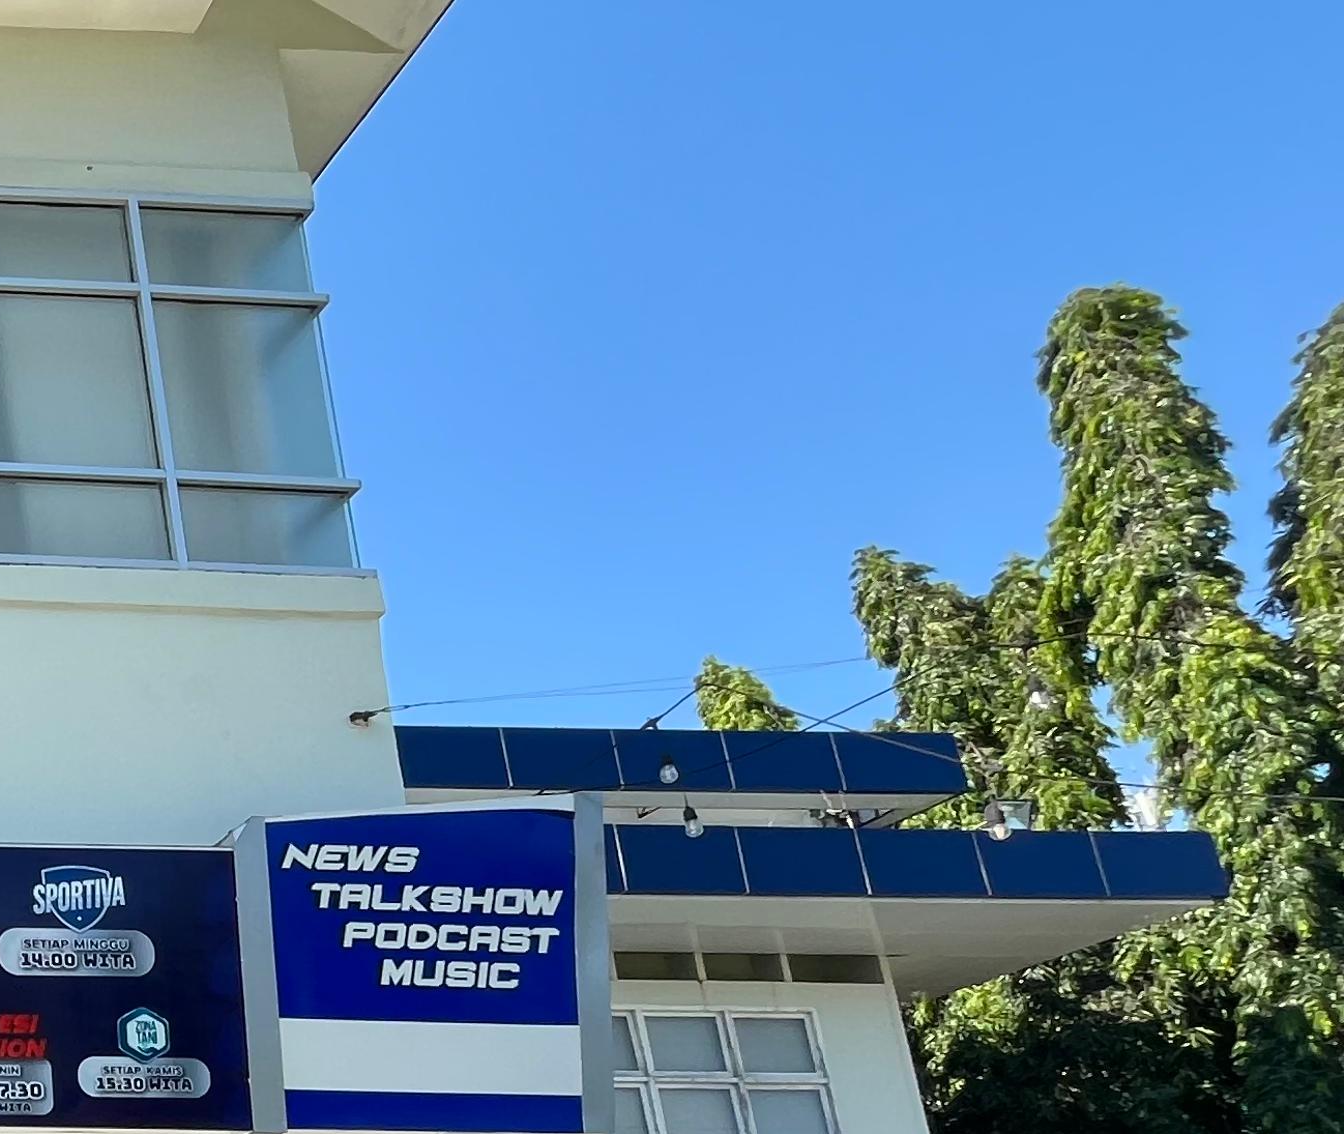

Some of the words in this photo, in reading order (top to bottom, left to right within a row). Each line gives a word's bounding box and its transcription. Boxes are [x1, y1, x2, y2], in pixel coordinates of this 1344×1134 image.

[282, 843, 420, 873] NEWS
[32, 876, 126, 915] SPORTIVA
[311, 882, 563, 916] TALKSHOW
[23, 939, 69, 949] SETIAP
[74, 939, 129, 950] MINGGU
[343, 921, 560, 954] PODCAST
[20, 952, 76, 967] 14.00
[83, 953, 135, 968] WITA
[380, 958, 521, 989] MUSIC
[96, 1077, 145, 1090] 15.30
[149, 1078, 192, 1091] WITA
[103, 1065, 141, 1075] SETIAP
